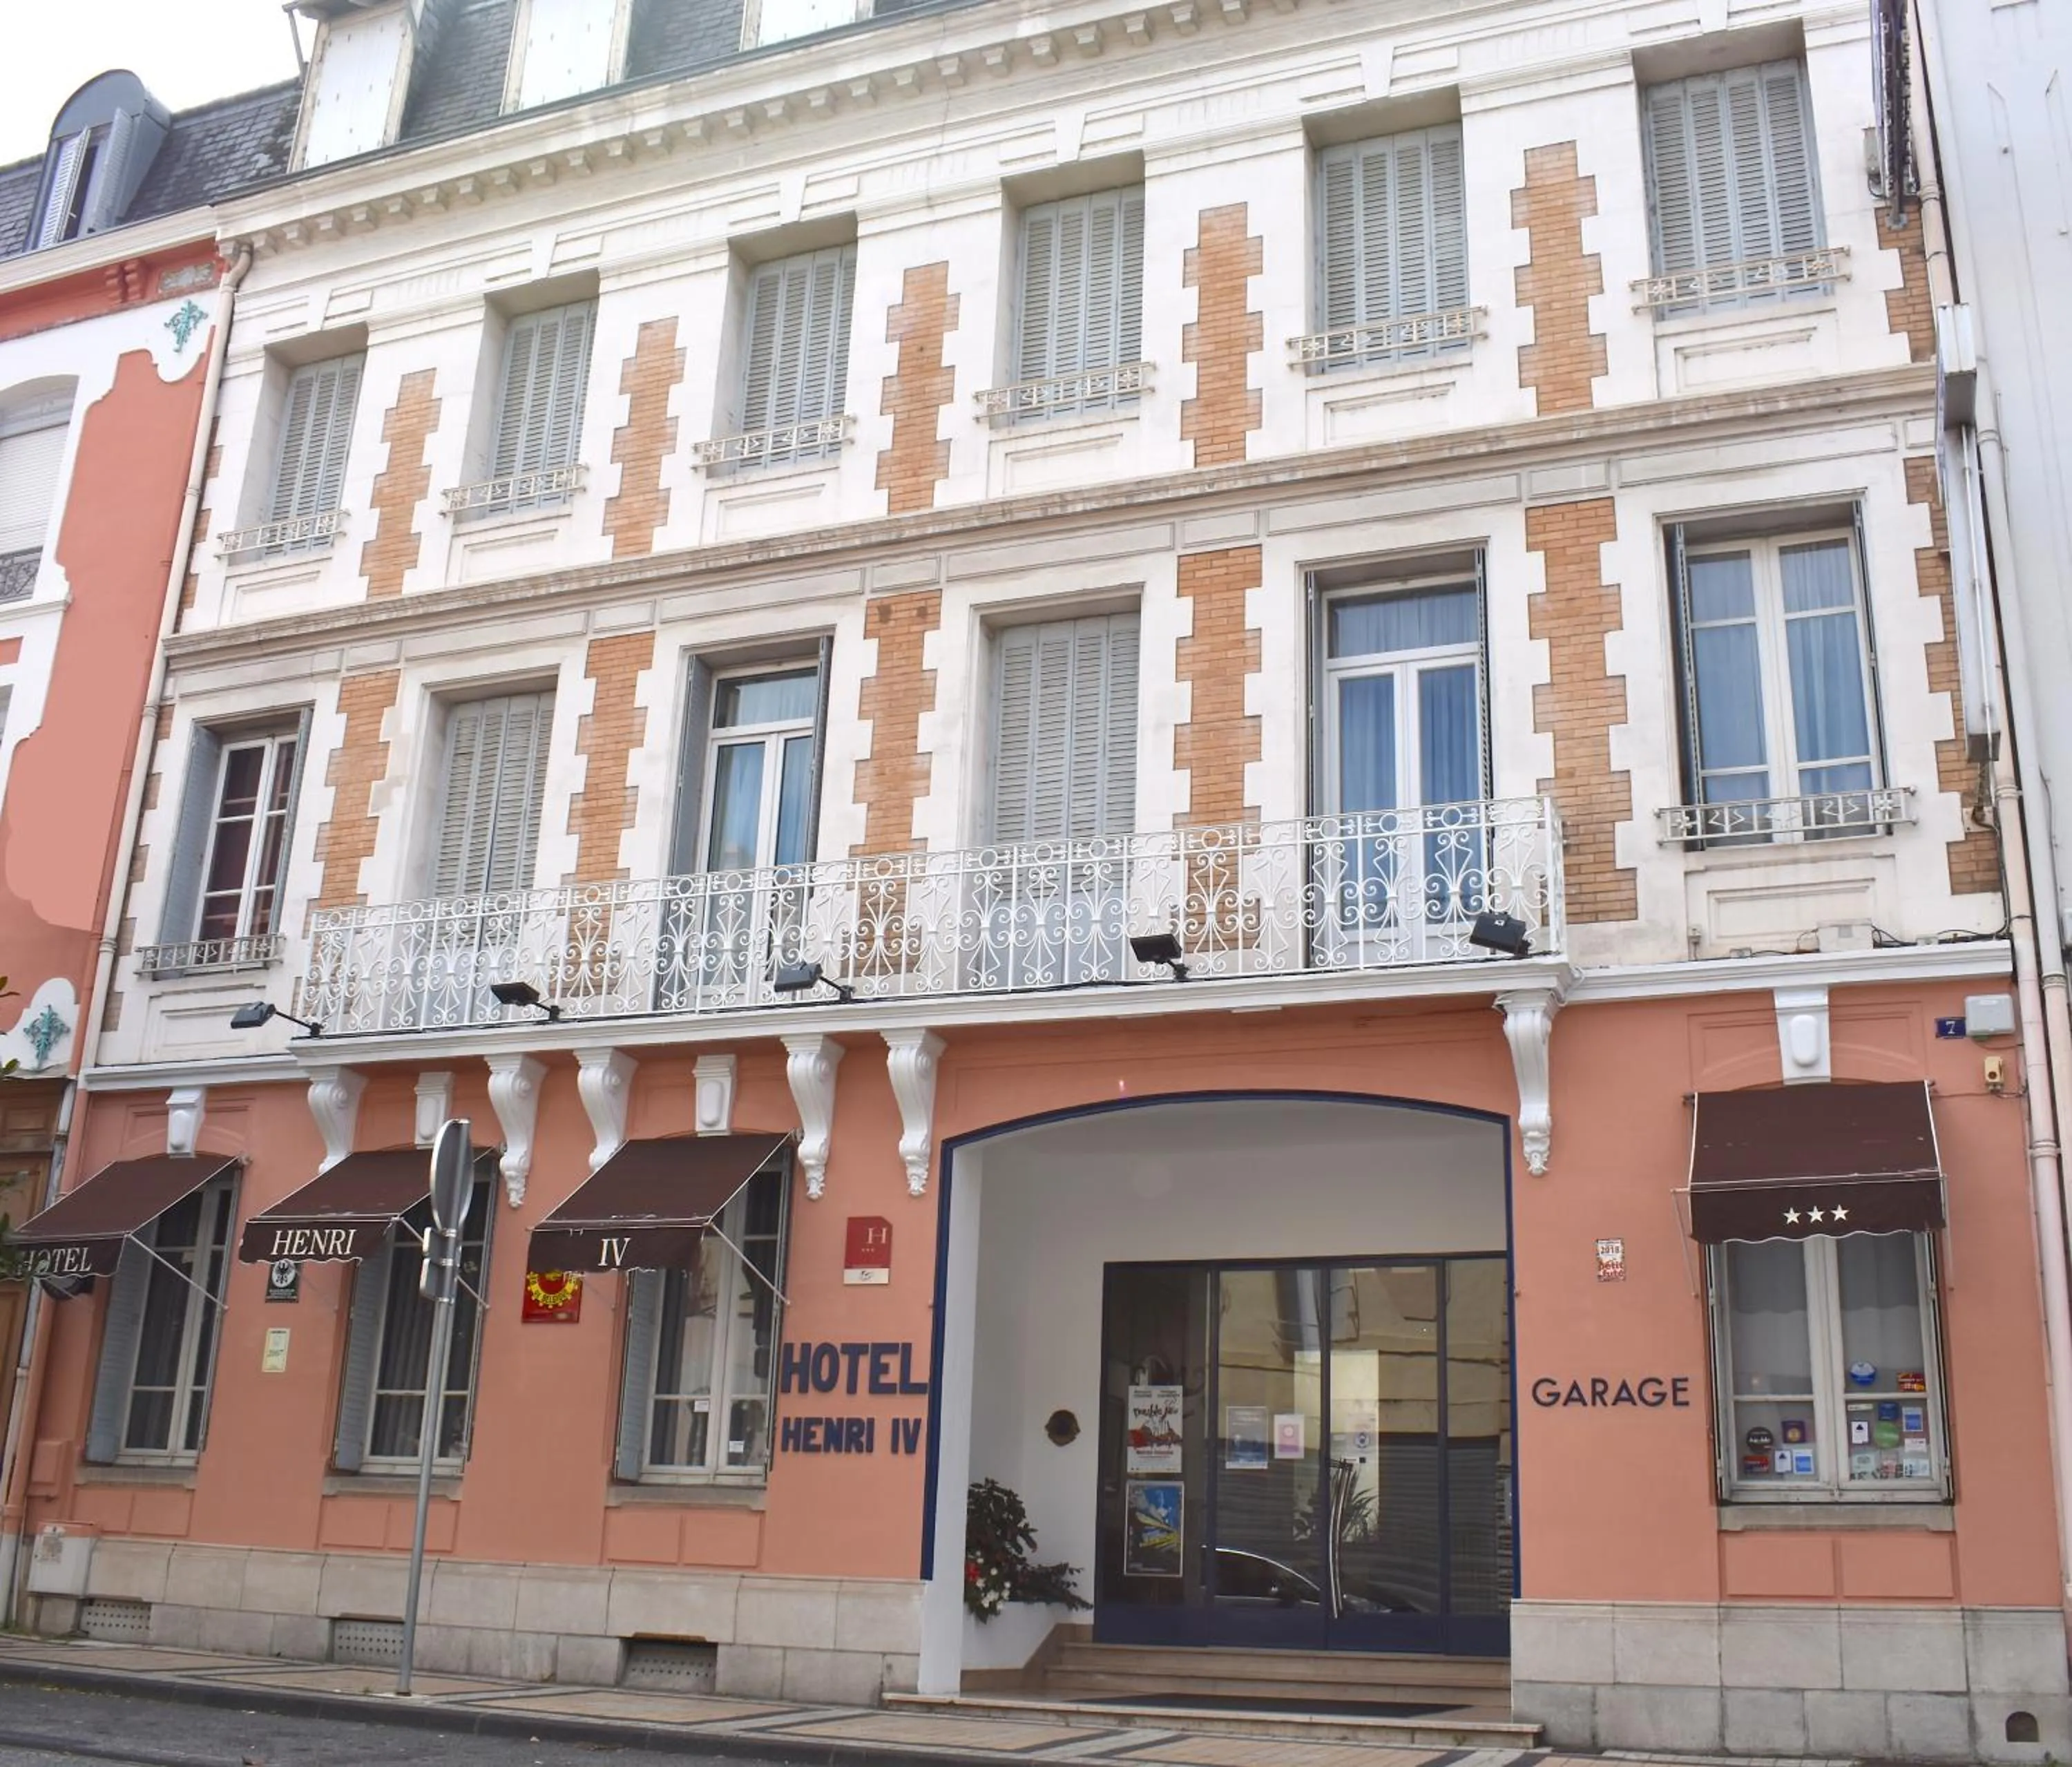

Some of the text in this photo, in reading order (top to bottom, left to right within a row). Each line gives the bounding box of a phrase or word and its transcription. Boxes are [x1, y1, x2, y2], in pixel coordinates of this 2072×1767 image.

[1946, 1020, 1955, 1034] 7
[270, 1229, 357, 1255] HENRI
[867, 1227, 888, 1244] H
[597, 1237, 631, 1266] IV
[780, 1341, 929, 1395] HOTEL
[1532, 1377, 1690, 1407] GARAGE
[780, 1417, 922, 1454] HENRI IV
